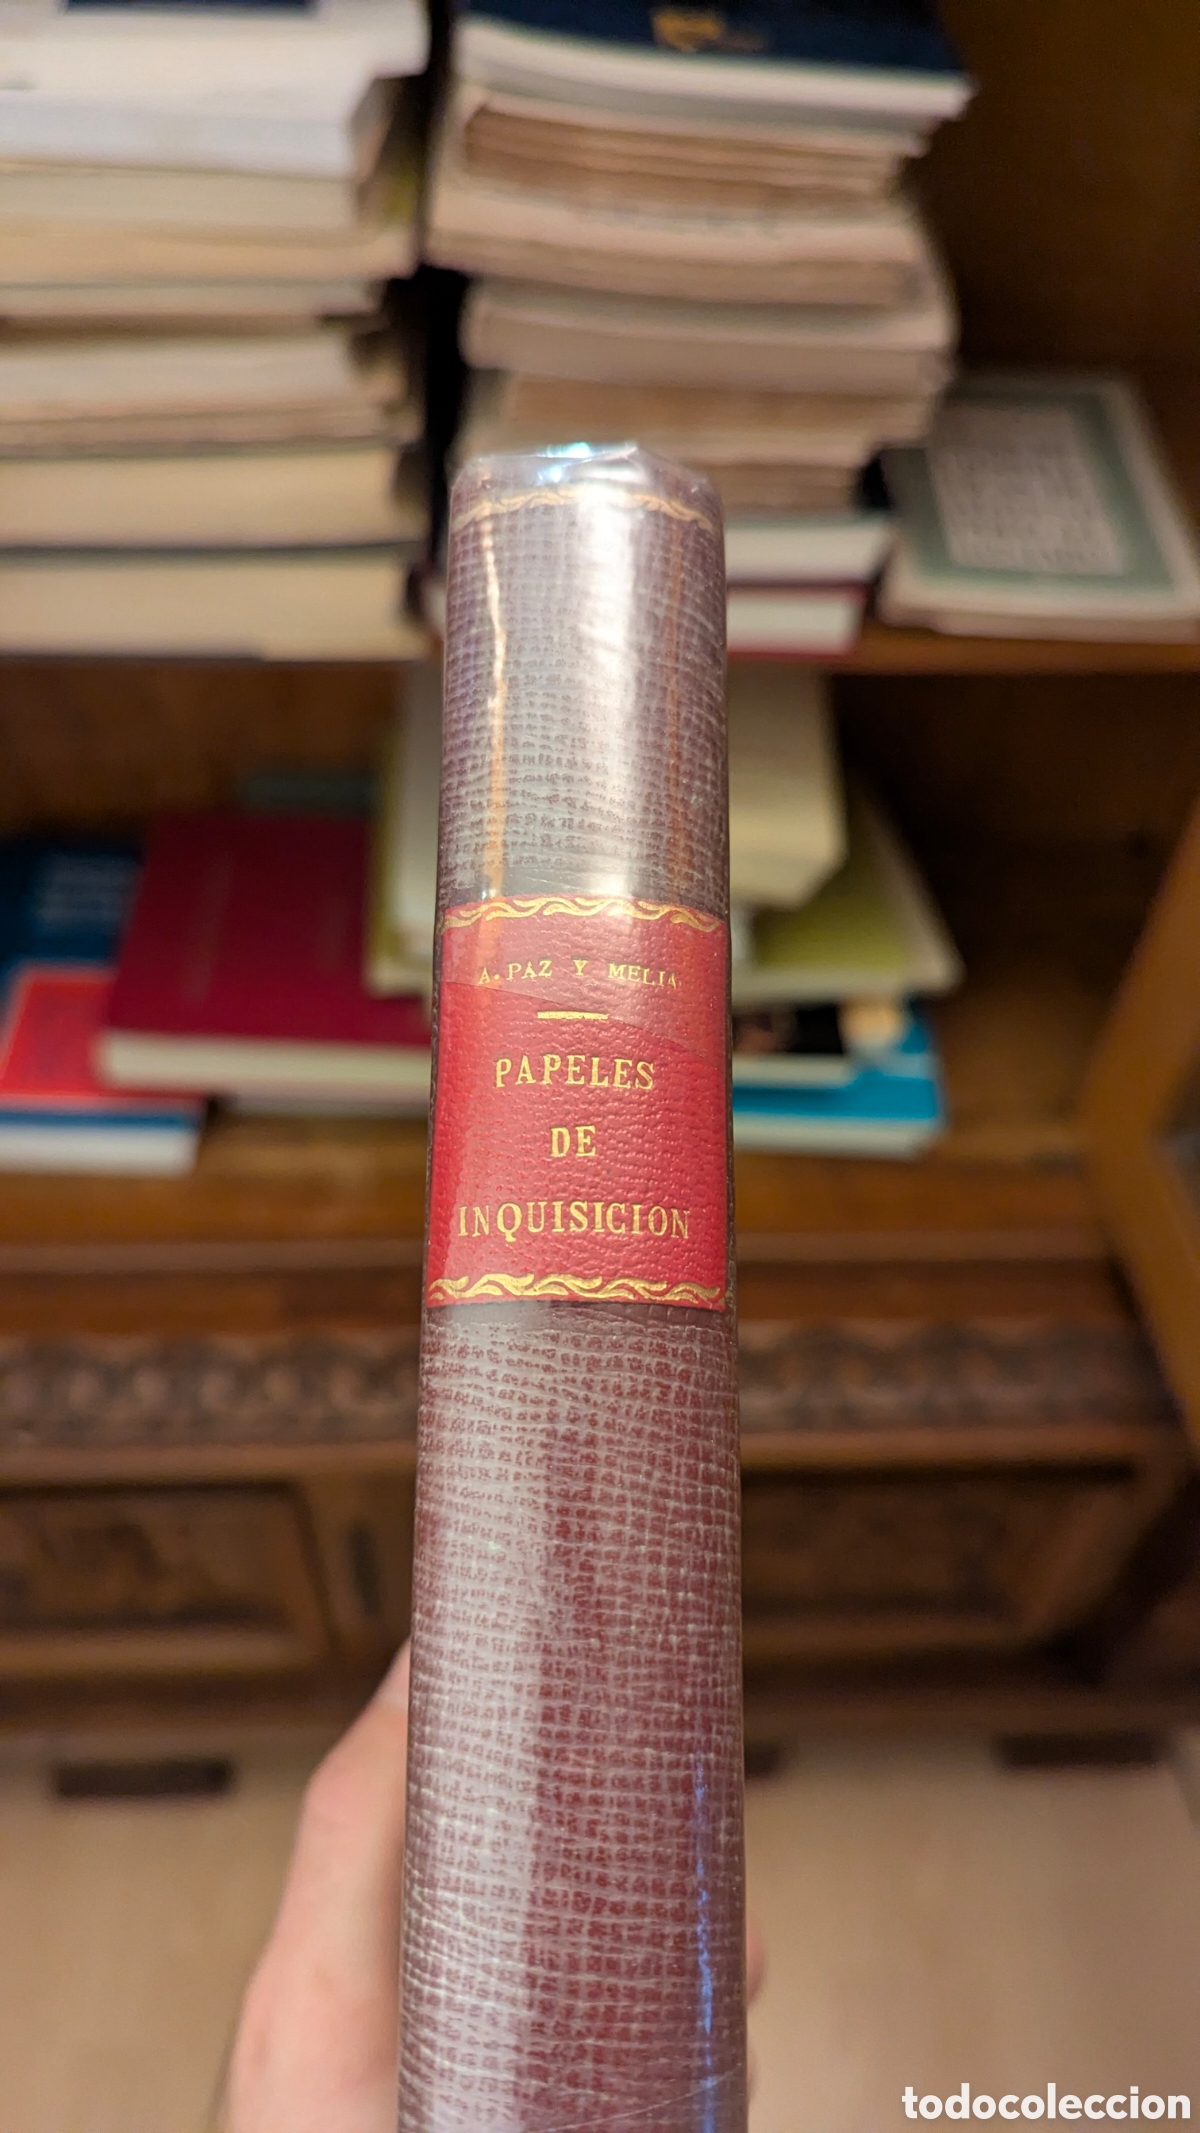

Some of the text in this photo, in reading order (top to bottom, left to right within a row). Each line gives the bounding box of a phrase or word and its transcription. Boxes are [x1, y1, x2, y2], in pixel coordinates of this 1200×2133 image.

[572, 959, 588, 976] Y
[607, 963, 678, 989] MELIA
[494, 1054, 655, 1090] PAPELES
[550, 1125, 596, 1158] DE
[457, 1200, 691, 1242] INQUISICION
